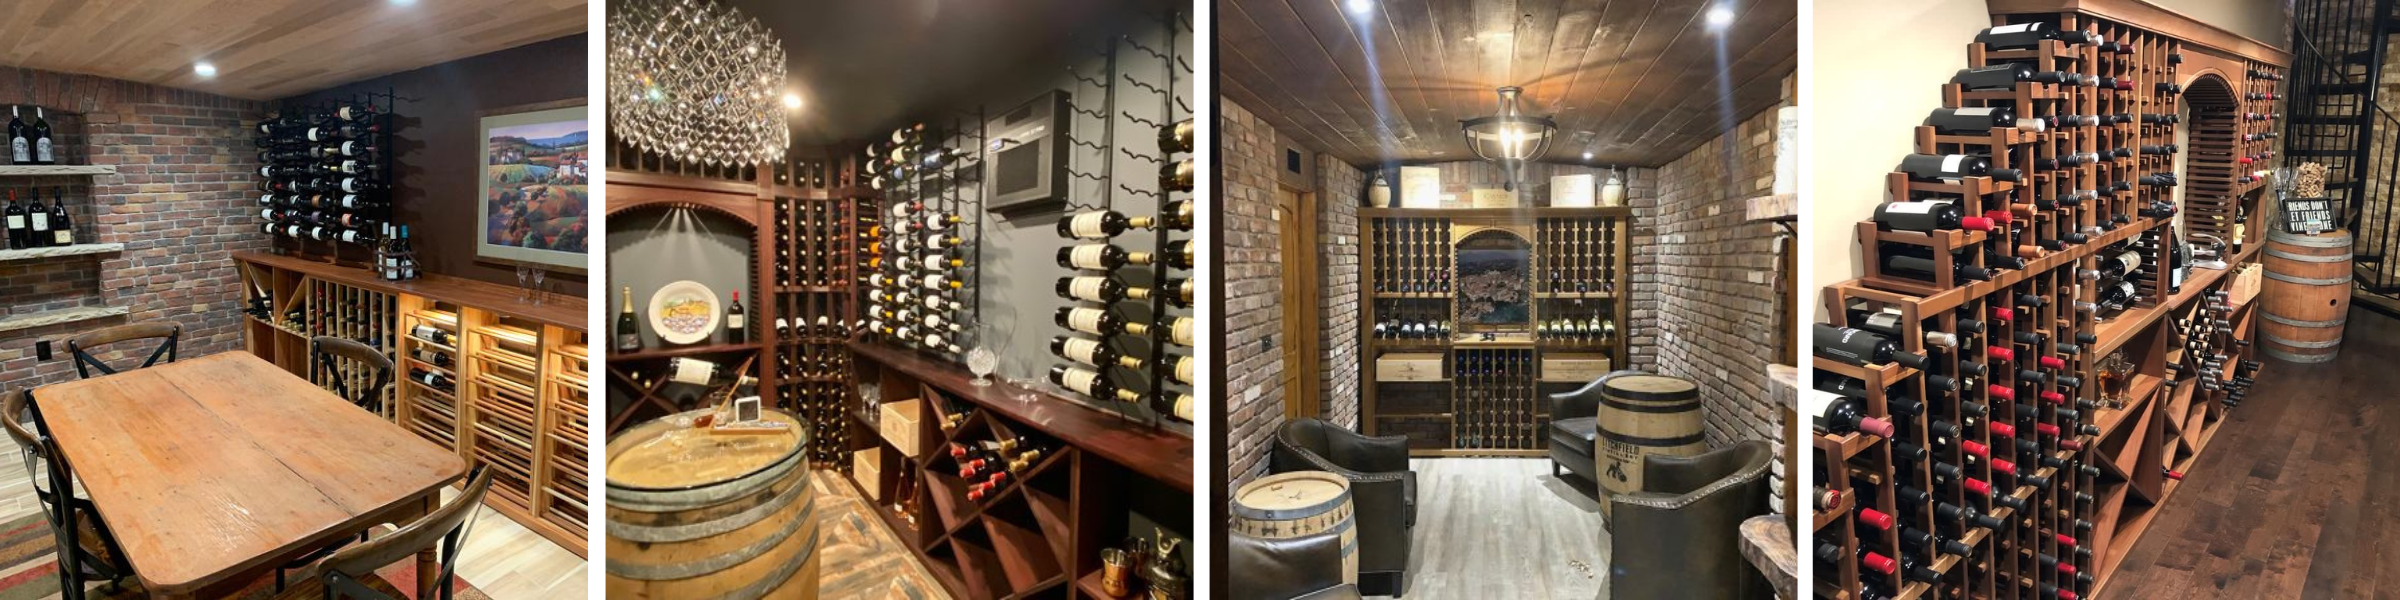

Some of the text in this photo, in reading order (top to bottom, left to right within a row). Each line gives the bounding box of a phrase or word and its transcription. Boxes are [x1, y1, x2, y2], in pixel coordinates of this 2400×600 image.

[2287, 200, 2328, 211] RIENDS DON'T
[2290, 210, 2331, 221] ET FRIENDS
